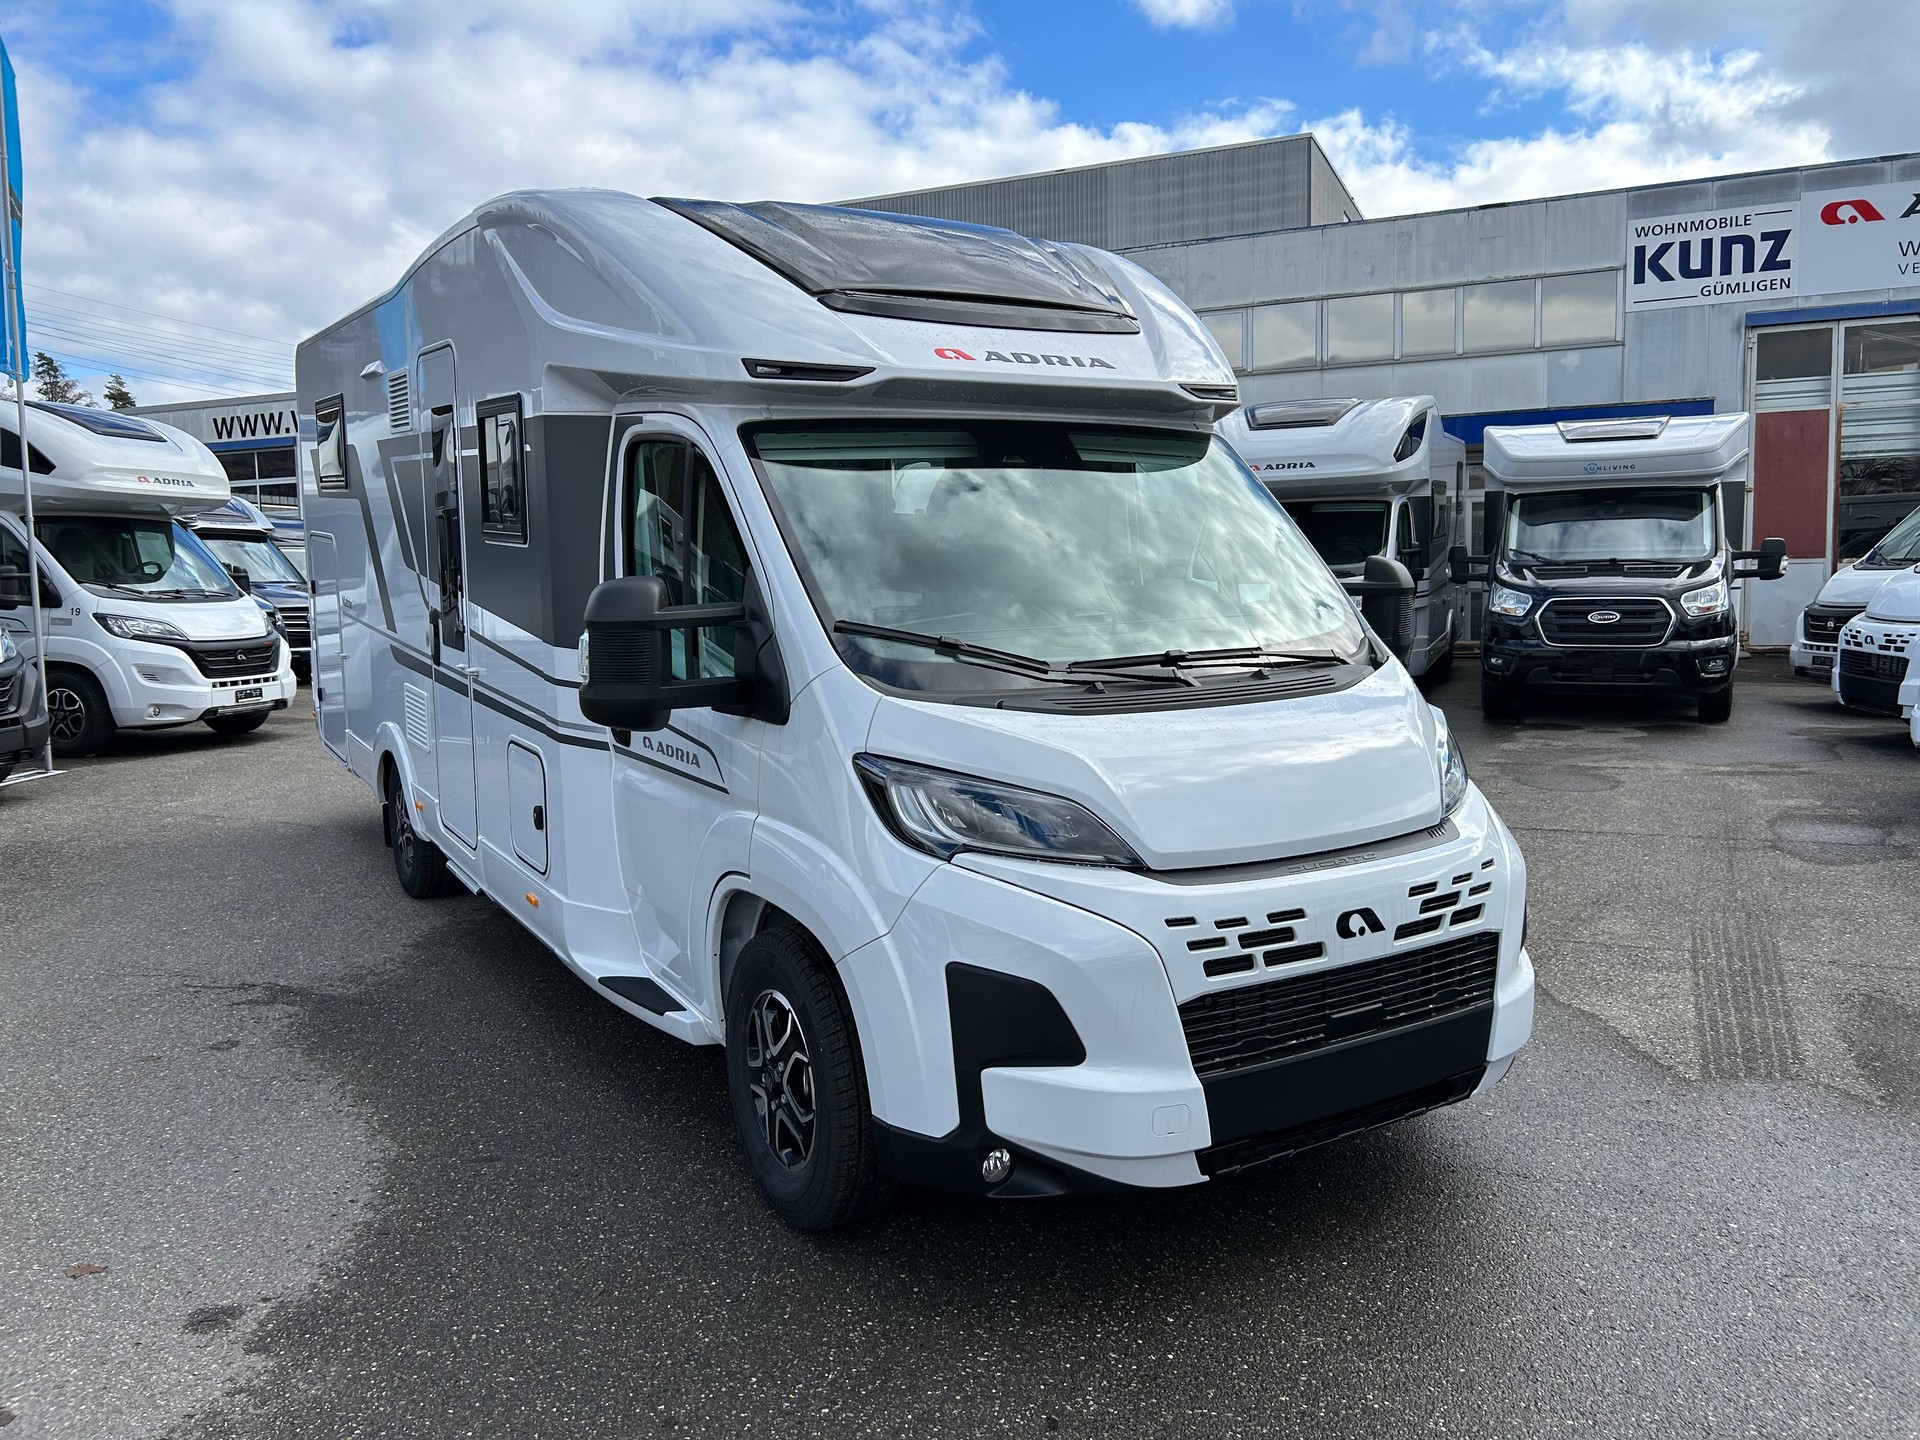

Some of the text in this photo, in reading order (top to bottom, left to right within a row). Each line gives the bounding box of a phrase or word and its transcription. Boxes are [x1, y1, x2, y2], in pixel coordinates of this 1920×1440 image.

[1635, 214, 1752, 239] WOHNMOBILE
[1700, 277, 1791, 297] GÜMLIGEN
[985, 350, 1117, 370] ADRIA
[1264, 462, 1315, 471] ADRIA
[153, 477, 195, 488] ADRIA
[70, 607, 81, 616] 19
[656, 740, 701, 769] ADRIA
